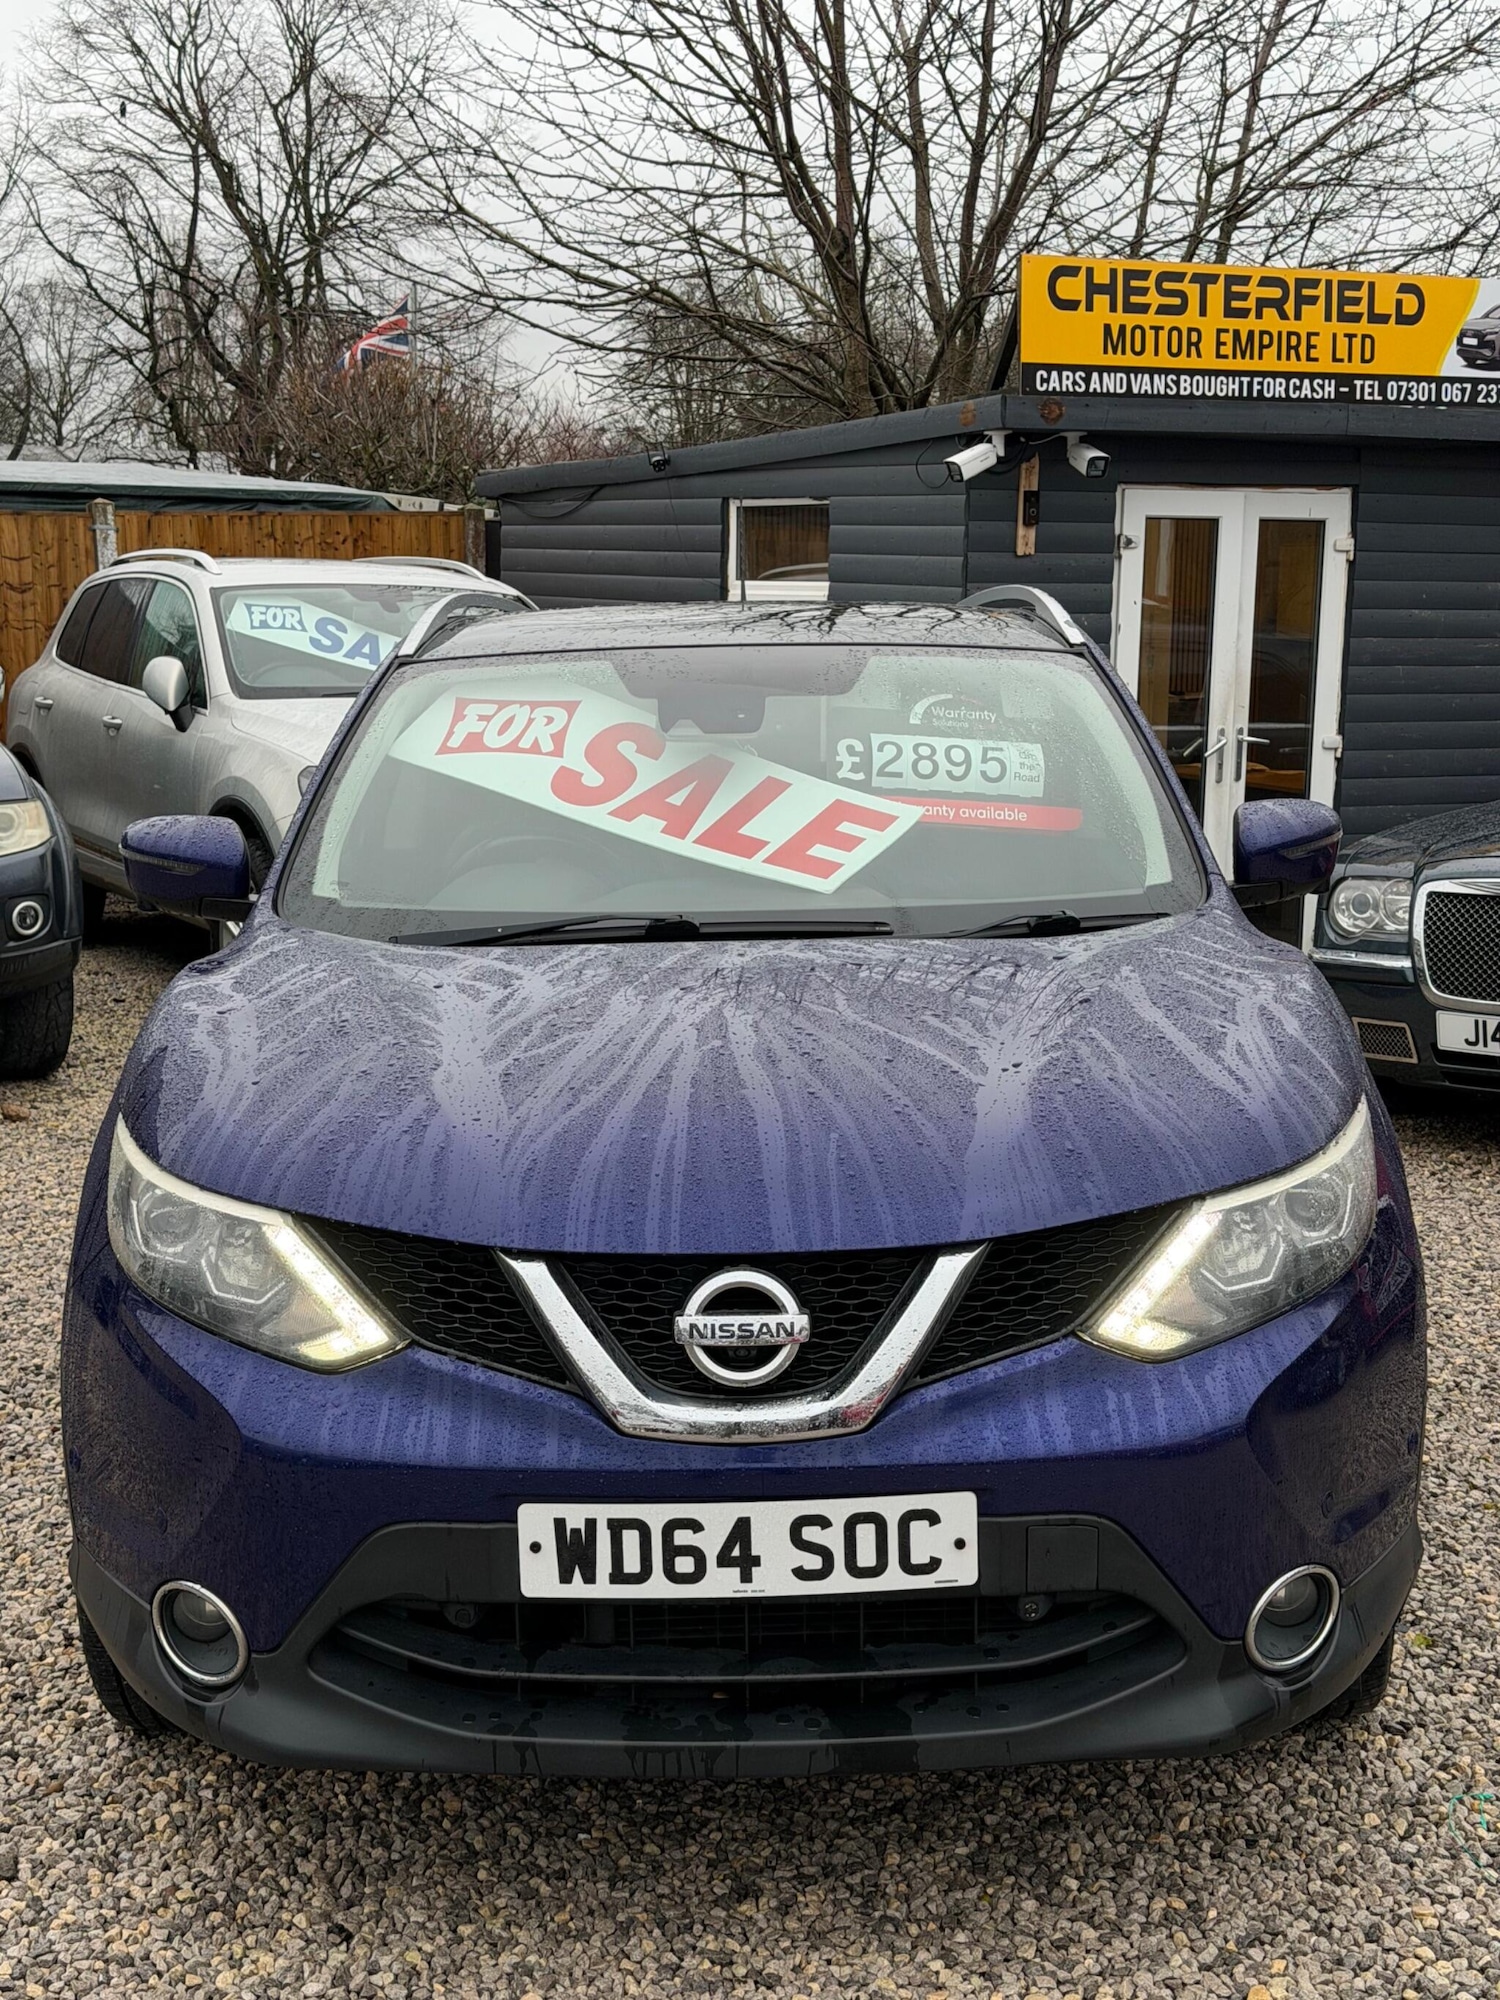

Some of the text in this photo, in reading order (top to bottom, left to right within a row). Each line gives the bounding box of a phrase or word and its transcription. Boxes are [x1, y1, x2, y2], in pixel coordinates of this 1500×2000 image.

[1047, 264, 1426, 326] CHESTERFIELD
[1102, 323, 1376, 364] MOTOR EMPIRE LTD
[1035, 369, 1087, 393] CARS
[1089, 371, 1127, 394] AND
[1129, 372, 1178, 396] VANS
[1179, 374, 1251, 398] BOUGHT
[1252, 377, 1287, 399] FOR
[1288, 378, 1336, 400] CASH
[1353, 379, 1383, 401] TEL
[1386, 380, 1437, 402] 07301
[1440, 382, 1473, 403] 067
[250, 605, 398, 667] FOR SA
[930, 705, 997, 723] Warranty
[931, 718, 970, 729] Solutions
[445, 702, 901, 880] FOR SALE
[1013, 771, 1041, 783] Road
[919, 804, 1028, 822] anty available
[688, 1321, 796, 1340] NISSAN
[552, 1508, 943, 1585] WD64 SOC
